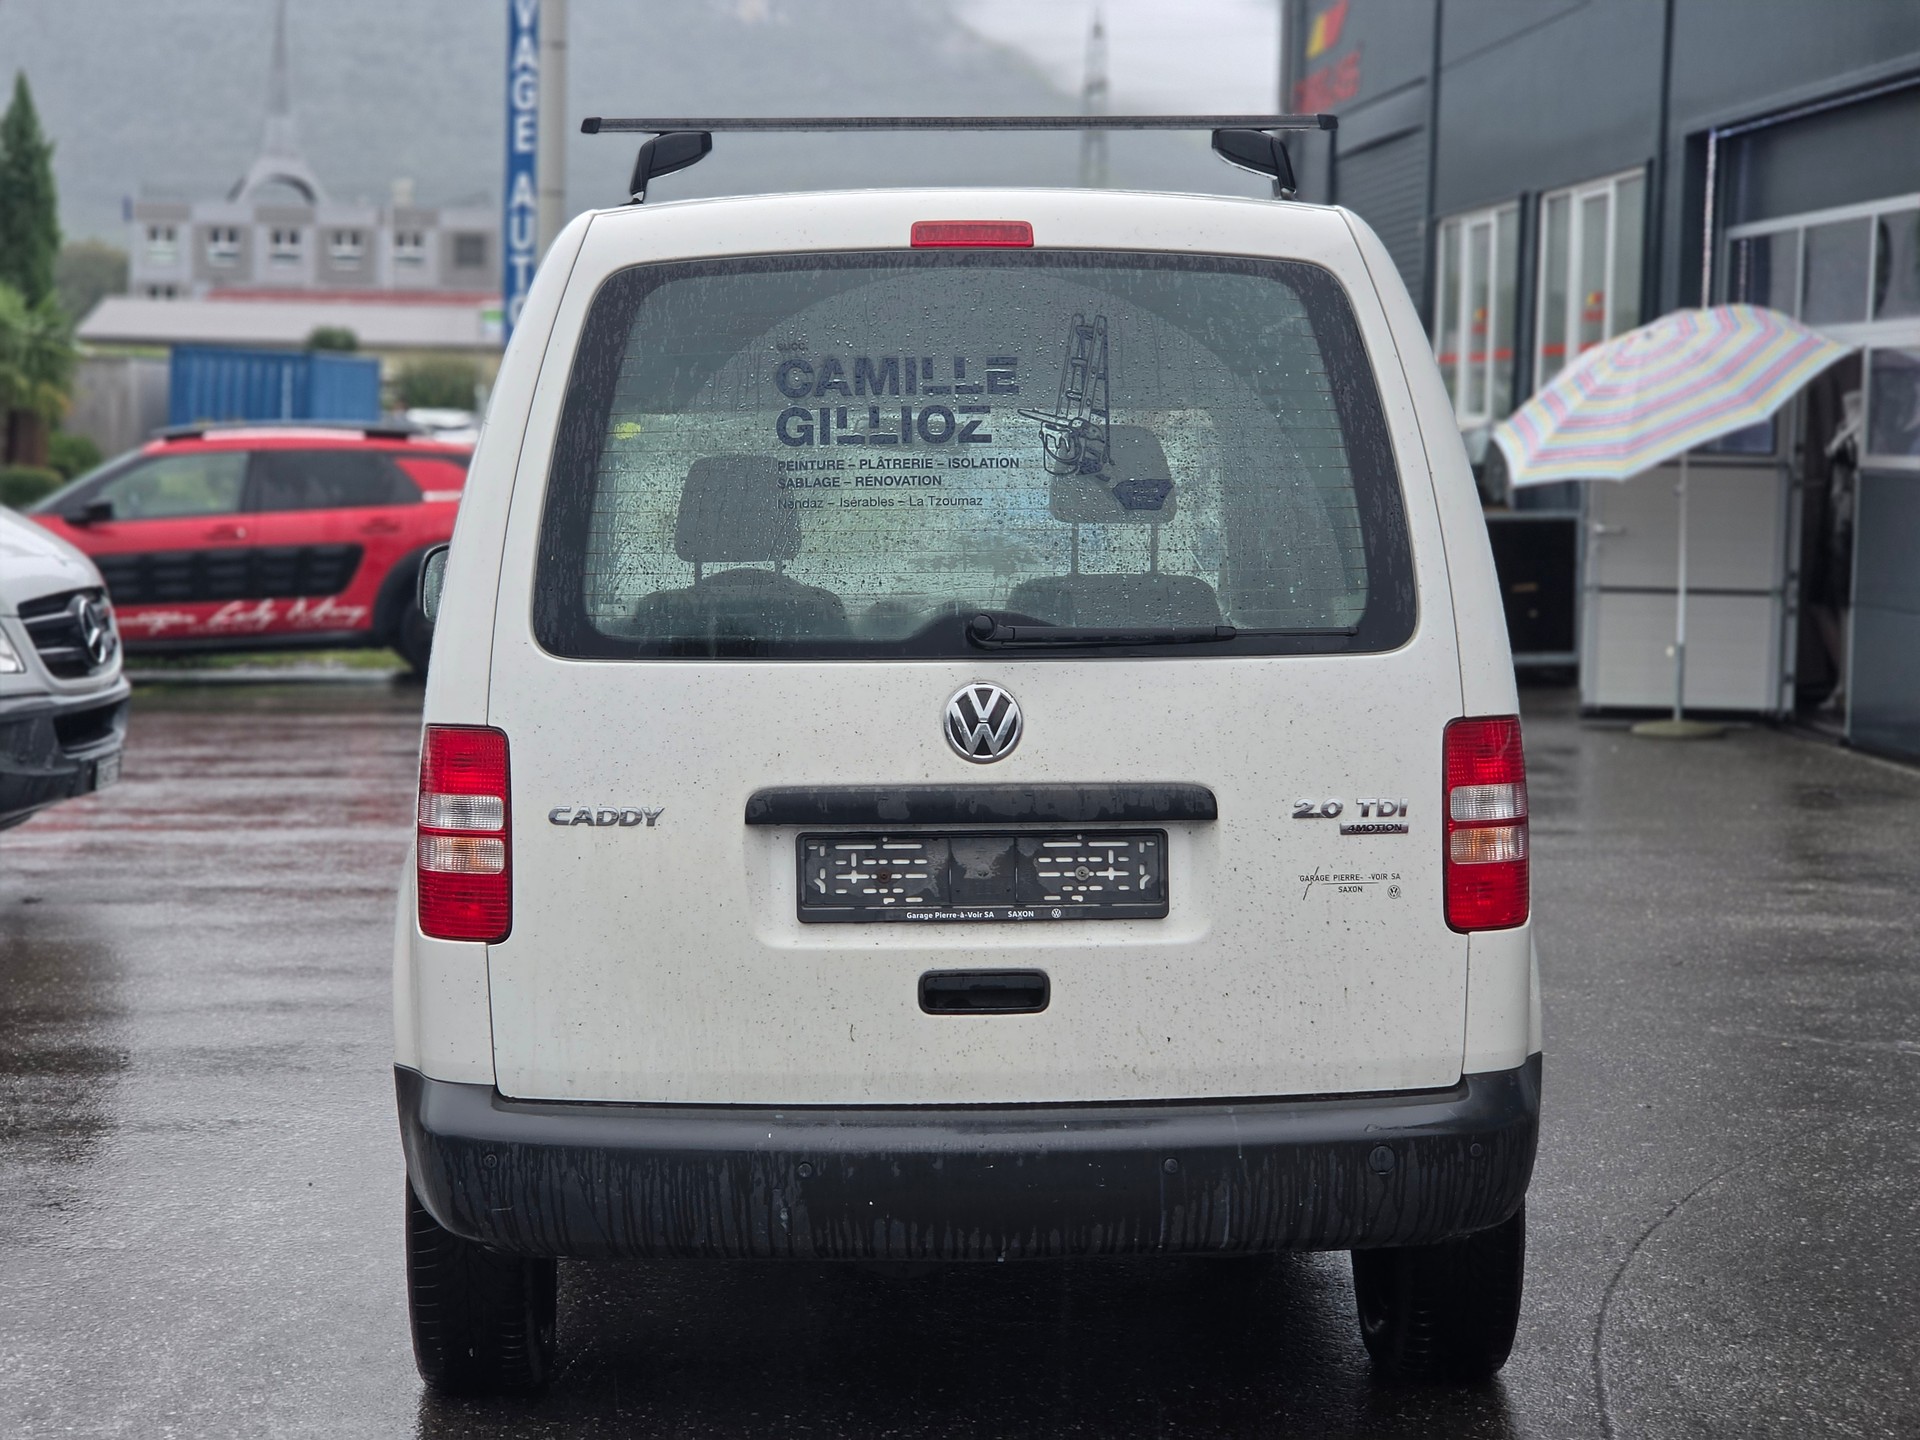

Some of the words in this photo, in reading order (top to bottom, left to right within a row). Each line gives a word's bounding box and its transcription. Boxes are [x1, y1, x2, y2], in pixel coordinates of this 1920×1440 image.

[776, 357, 1020, 398] CAMILLE
[776, 405, 992, 447] GILLIOZ
[778, 459, 845, 471] PEINTURE
[859, 456, 934, 470] PLÂTRERIE
[948, 457, 1020, 469] ISOLATION
[777, 476, 841, 489] SABLAGE
[855, 473, 942, 487] RÉNOVATION
[778, 497, 824, 510] Nendaz
[840, 496, 895, 508] Isérables
[909, 495, 924, 507] La
[927, 495, 983, 507] Tzoumaz
[548, 805, 665, 827] CADDY
[1292, 798, 1344, 819] 2.0
[1356, 798, 1409, 818] TDI
[1347, 823, 1403, 832] 4MOTION
[1299, 874, 1330, 882] GARAGE
[1391, 872, 1401, 880] SA
[1338, 885, 1363, 893] SAXON
[906, 911, 934, 921] Garage
[984, 911, 995, 919] SA
[1007, 910, 1034, 918] SAXON
